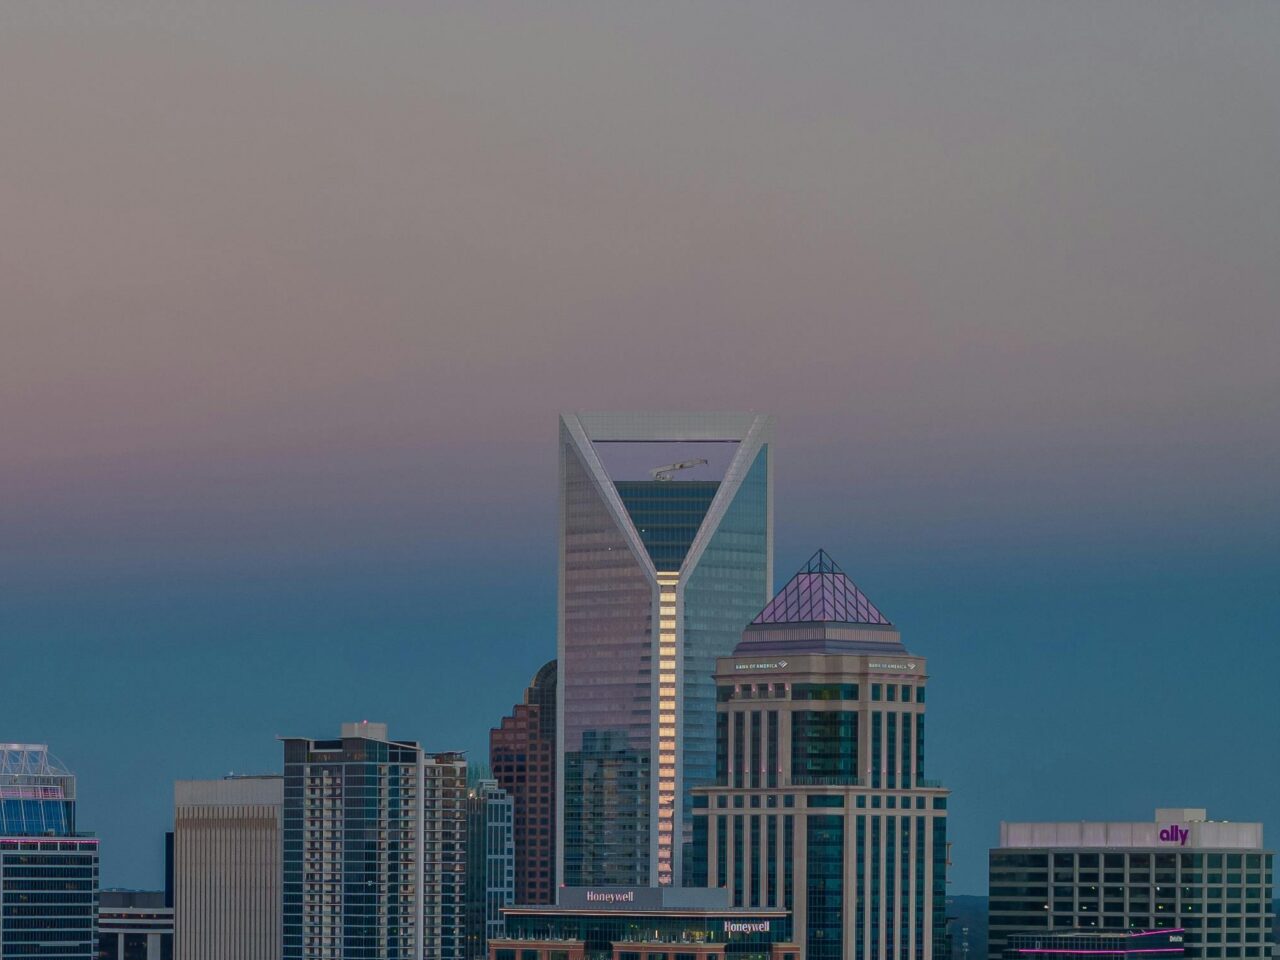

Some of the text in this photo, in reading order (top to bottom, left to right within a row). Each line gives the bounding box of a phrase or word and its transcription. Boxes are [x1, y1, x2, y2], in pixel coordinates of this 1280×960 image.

[1160, 824, 1189, 846] ally
[586, 891, 634, 904] Honeywell
[724, 921, 770, 934] Honeywell
